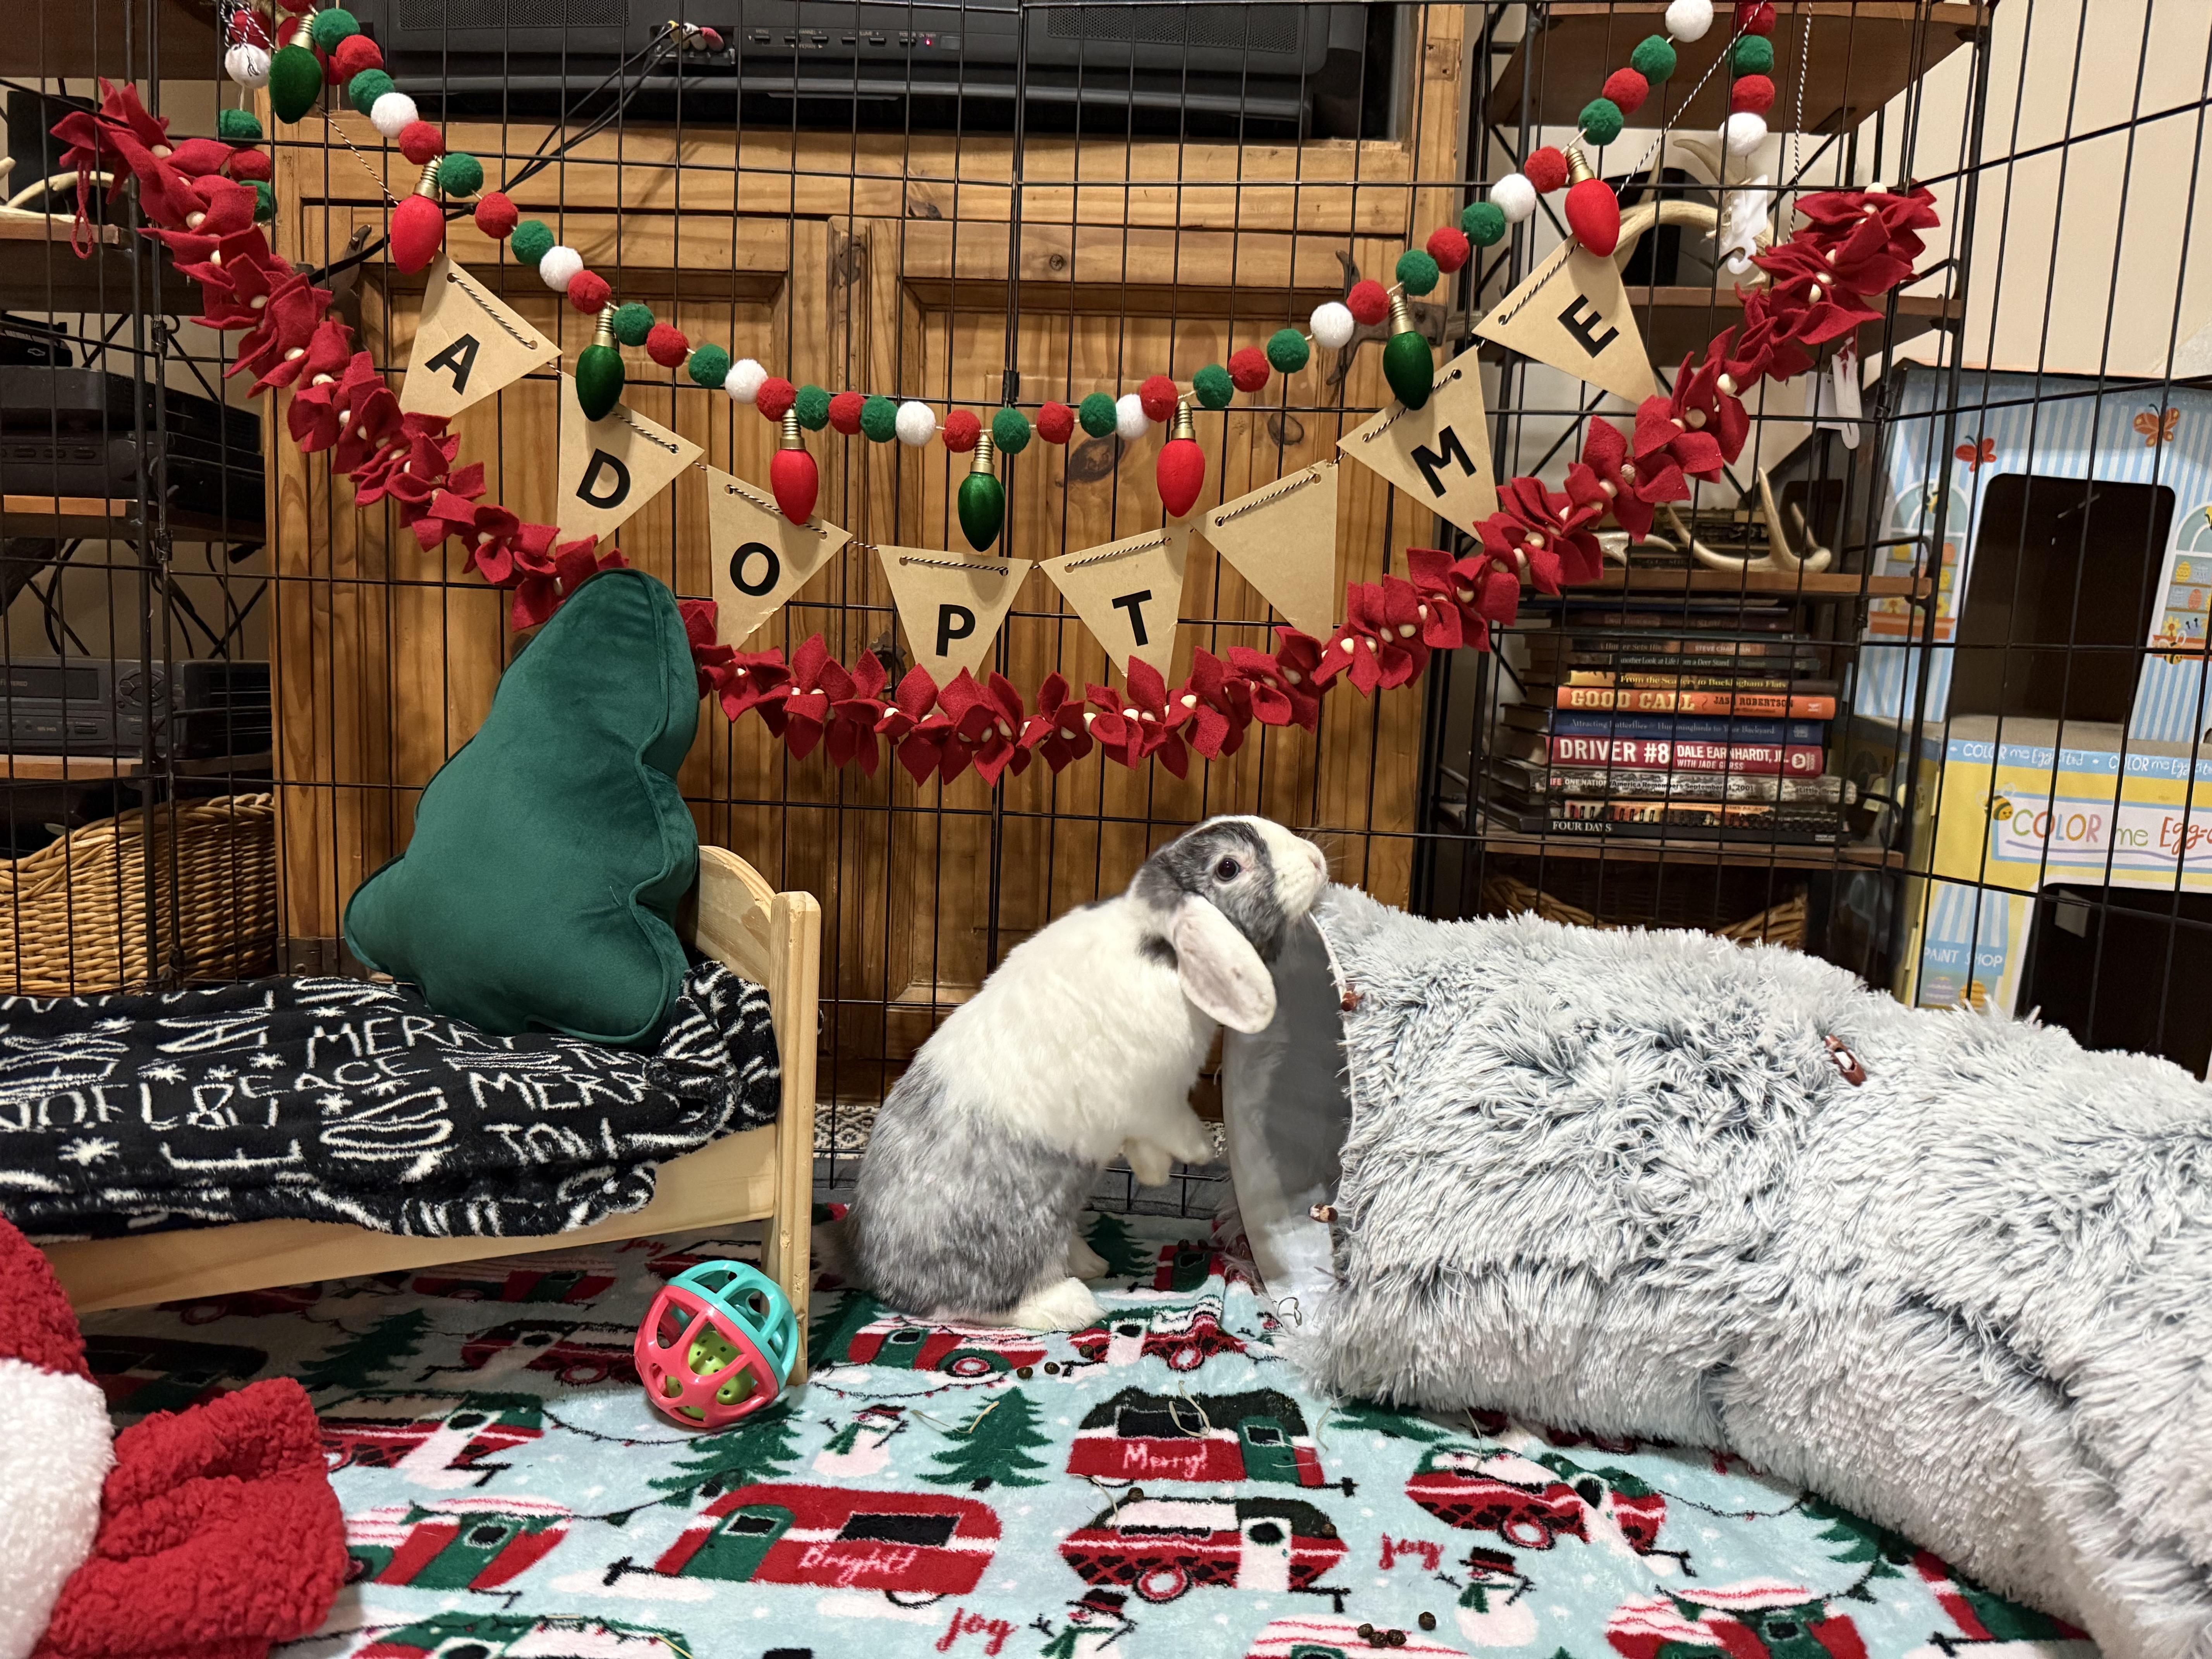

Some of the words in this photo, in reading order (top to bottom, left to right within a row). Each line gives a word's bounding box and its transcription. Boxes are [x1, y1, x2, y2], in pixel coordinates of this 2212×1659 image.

[1620, 675, 1644, 684] From
[1571, 690, 1631, 709] GOOD
[1639, 692, 1695, 711] CALL
[1559, 739, 1636, 762] DRIVER
[1644, 742, 1670, 764] #8
[1677, 745, 1704, 759] DALE
[1677, 759, 1696, 768] WITH
[1698, 760, 1716, 769] JADE
[1719, 761, 1743, 771] GRSS
[1550, 778, 1562, 786] IFE
[1736, 785, 1753, 793] 2001
[1553, 821, 1581, 831] FOUR
[2012, 809, 2102, 843] COLOR
